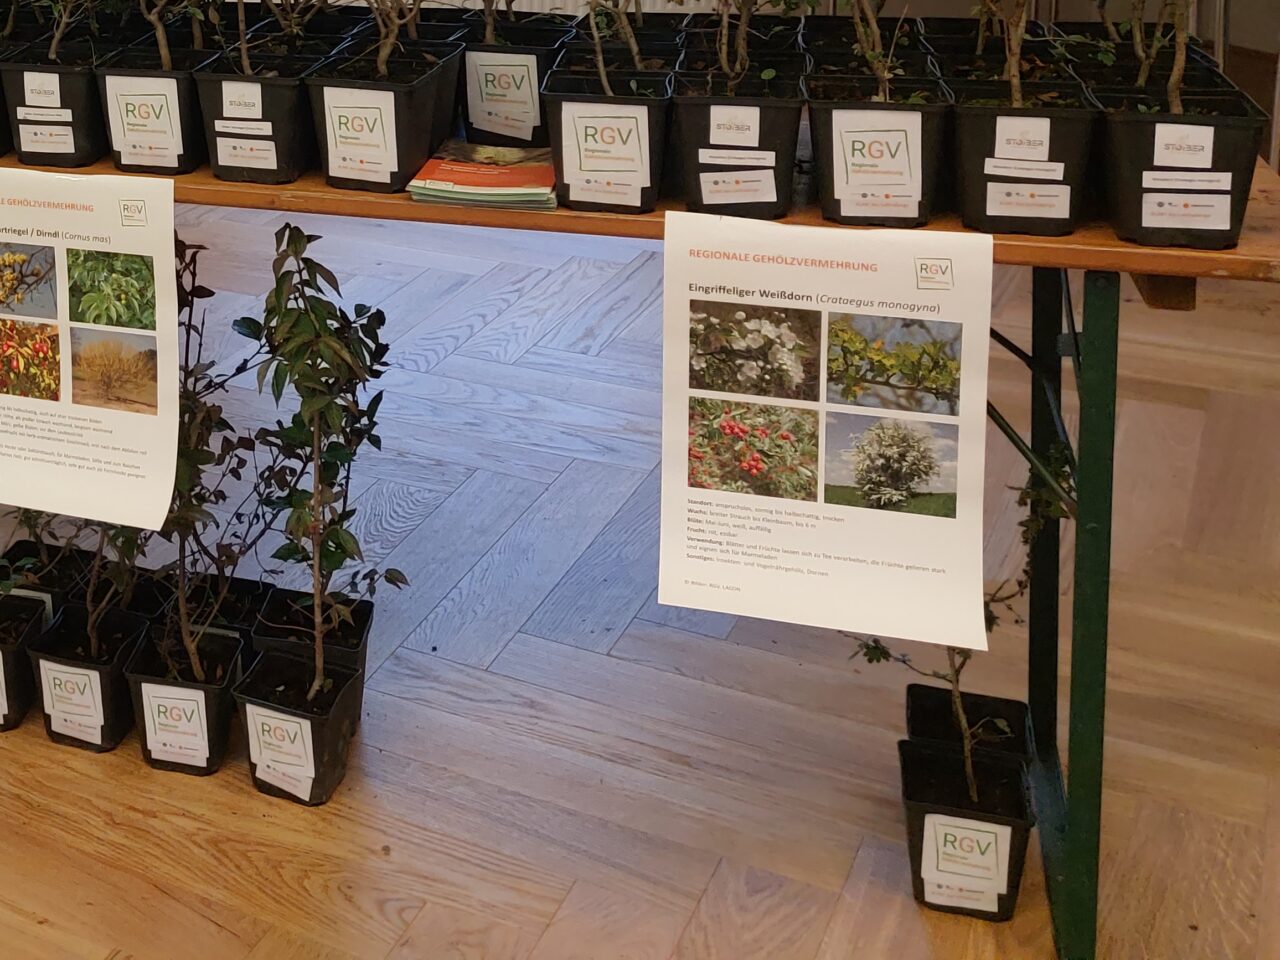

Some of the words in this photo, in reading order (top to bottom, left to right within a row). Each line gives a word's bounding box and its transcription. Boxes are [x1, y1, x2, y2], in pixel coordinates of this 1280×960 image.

[485, 73, 525, 90] RGV
[126, 103, 163, 120] RGV
[338, 115, 377, 134] RGV
[585, 126, 633, 145] RGV
[852, 140, 901, 159] RGV
[7, 198, 94, 212] GEHÖLZVERMEHRUNG
[123, 204, 143, 215] RGV
[37, 229, 60, 239] Dirndl
[62, 231, 90, 242] (Cornus
[690, 249, 750, 262] REGIONALE
[753, 254, 878, 272] GEHÖLZVERMEHRUNG
[920, 263, 949, 275] RGV
[689, 283, 756, 298] Eingriffeliger
[760, 290, 813, 302] Weißdorn
[816, 294, 875, 308] (Crataegus
[878, 300, 941, 314] monogyna)
[53, 677, 87, 696] RGV
[158, 704, 195, 723] RGV
[261, 722, 298, 744] RGV
[943, 833, 992, 856] RGV
